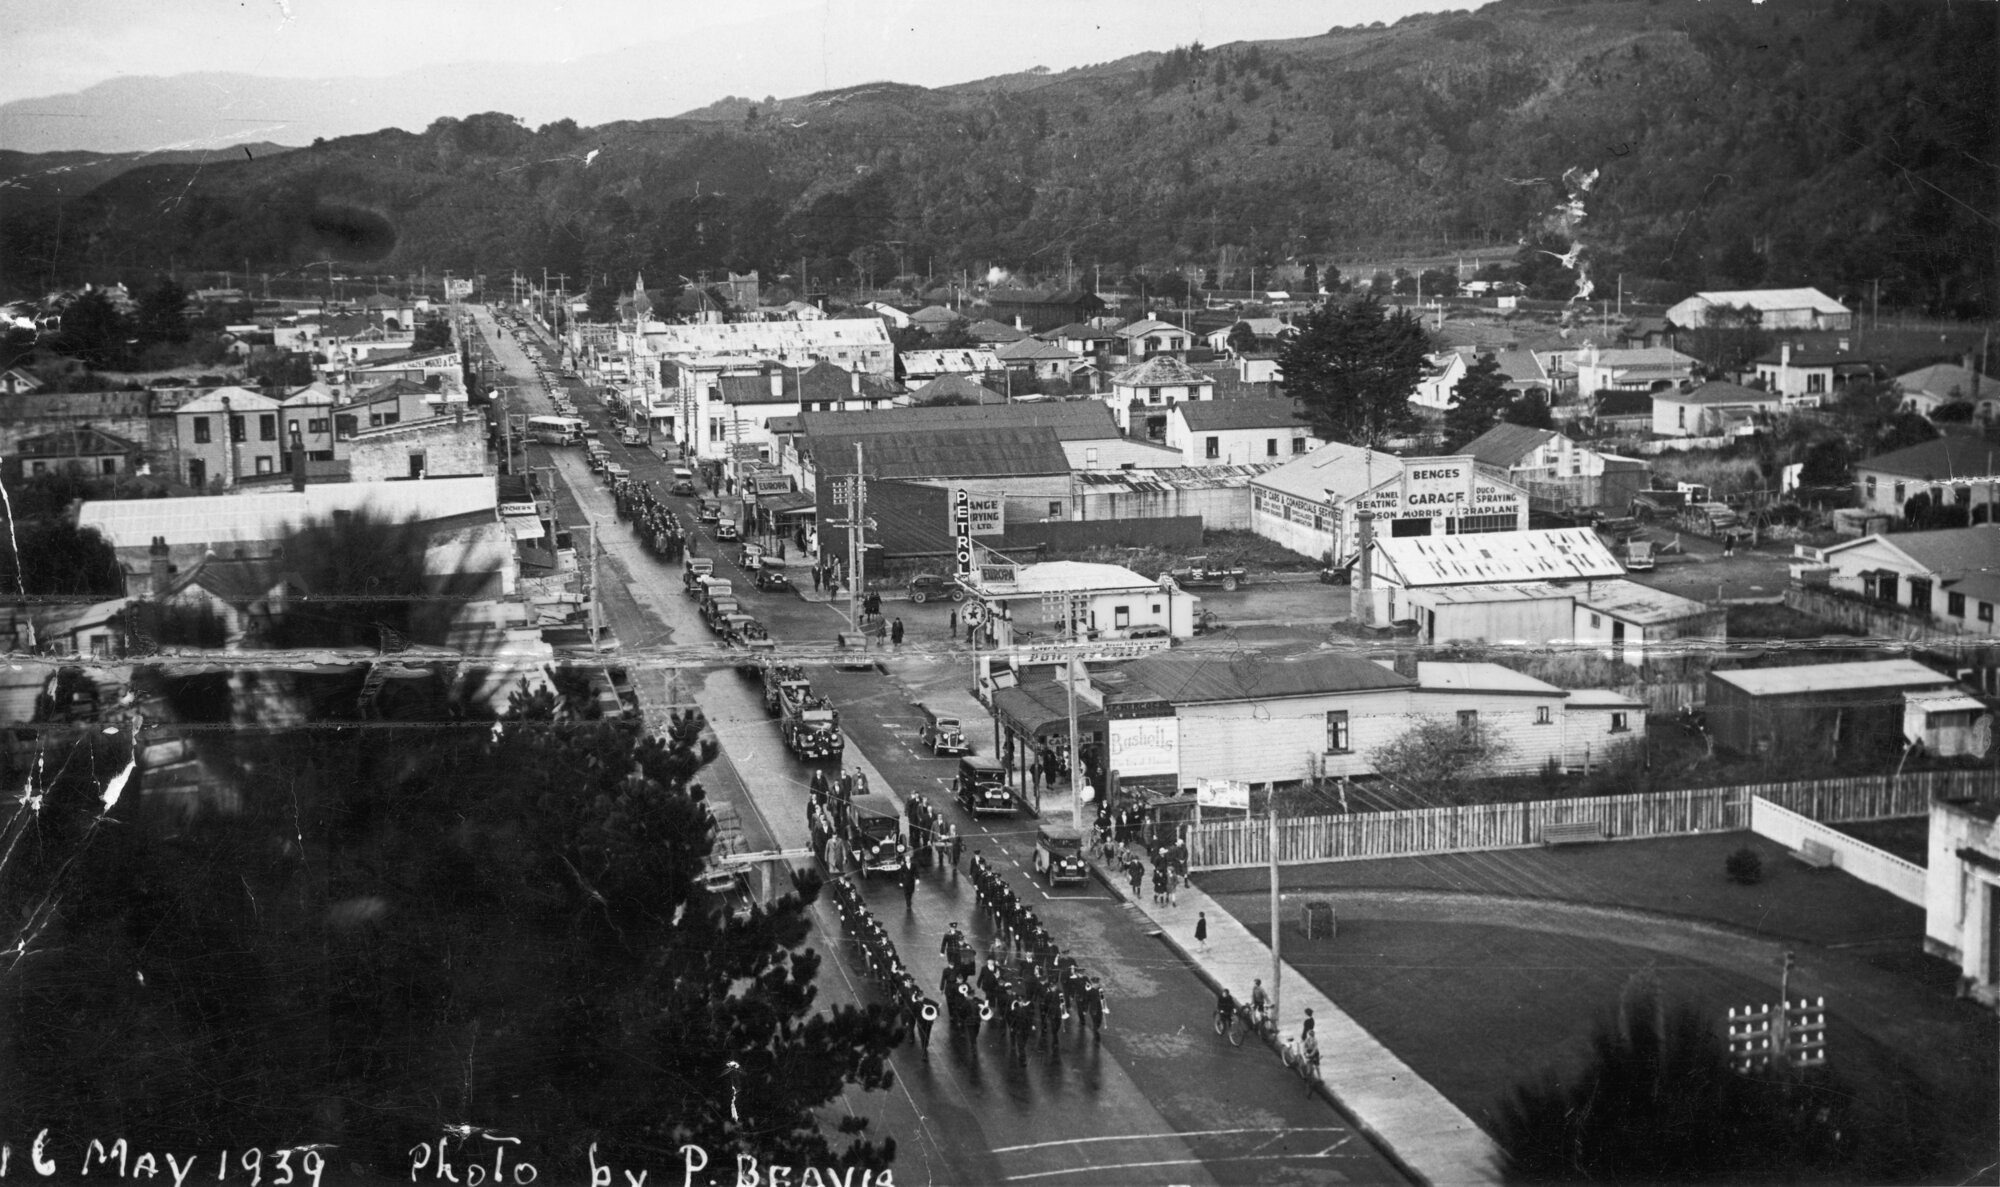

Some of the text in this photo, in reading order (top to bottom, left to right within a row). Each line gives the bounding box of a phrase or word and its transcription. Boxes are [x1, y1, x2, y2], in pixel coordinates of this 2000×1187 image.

[1413, 469, 1460, 480] BENGES
[759, 482, 789, 490] EUROPA
[1376, 491, 1399, 499] PANEL
[1408, 492, 1465, 505] GARAGE
[1476, 494, 1517, 503] SPRAYING
[1356, 499, 1397, 509] BEATING
[1354, 504, 1519, 520] DSON MORRIS RRAPLANE
[957, 492, 970, 575] PETROL
[982, 568, 1015, 581] EUROPA
